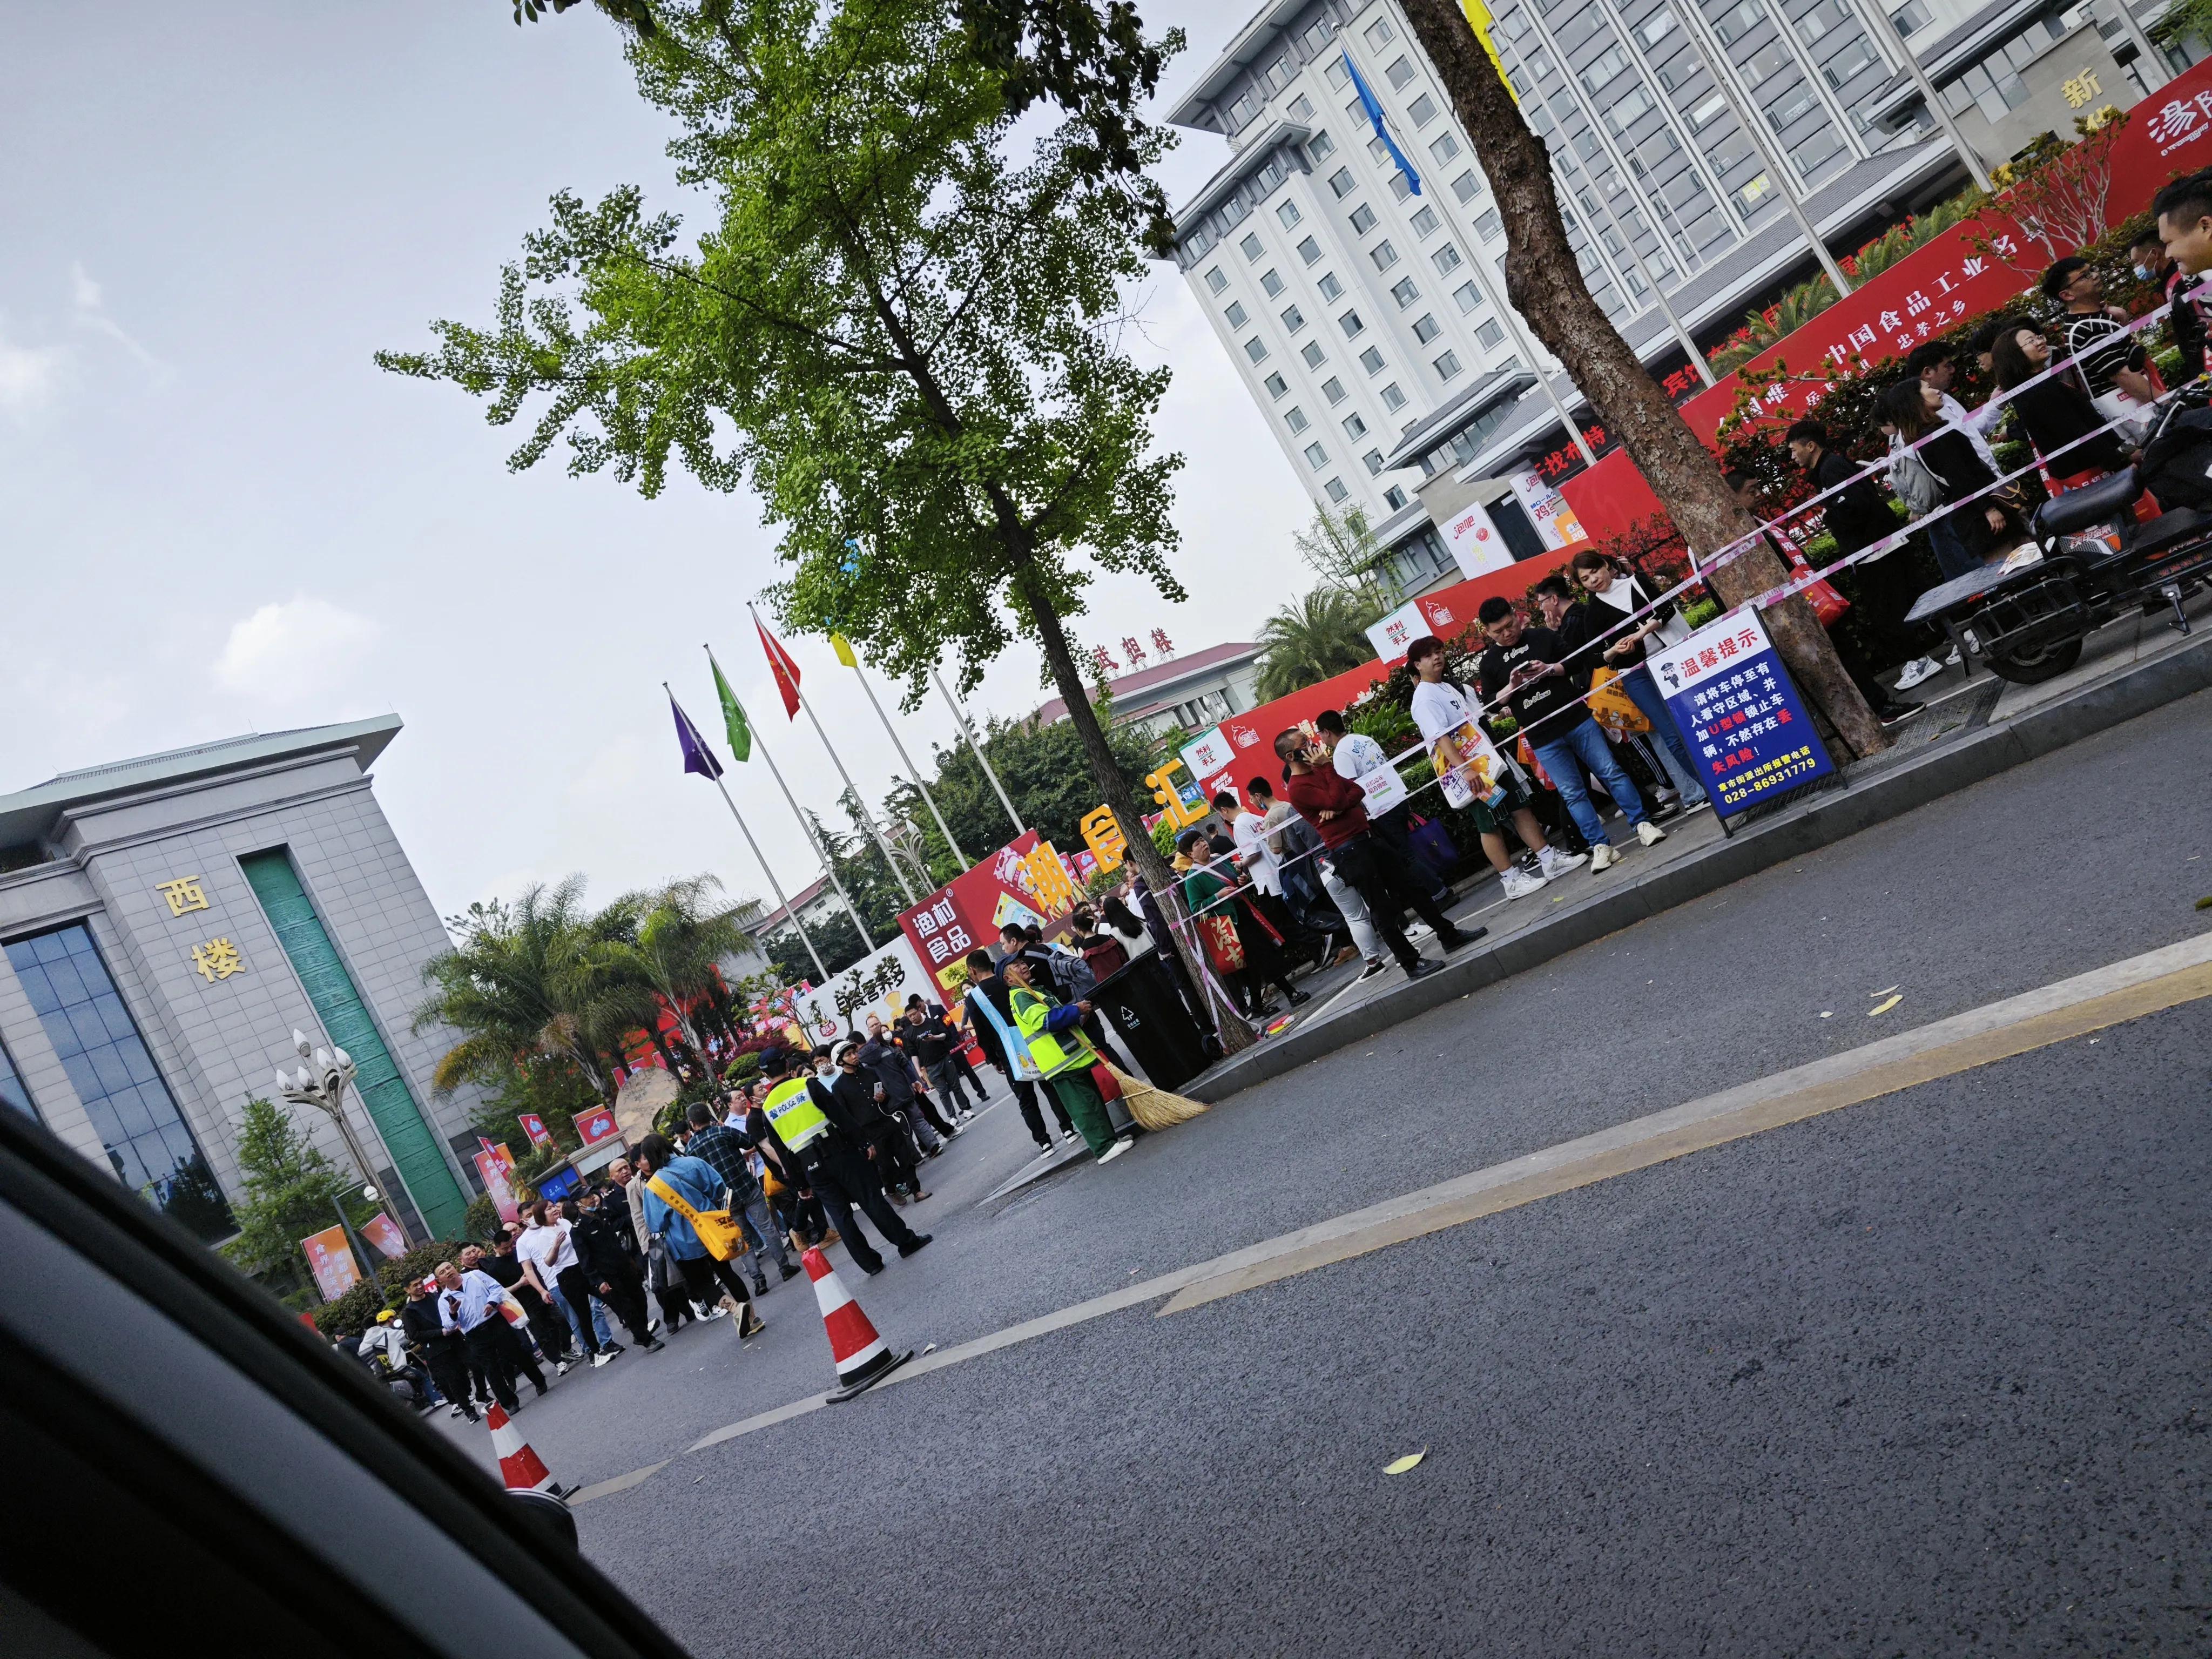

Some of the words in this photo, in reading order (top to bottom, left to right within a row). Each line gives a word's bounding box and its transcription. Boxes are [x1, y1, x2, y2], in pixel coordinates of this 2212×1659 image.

[1896, 299, 1966, 350] 忠孝之乡
[1092, 627, 1175, 670] 武担楼
[1392, 631, 1410, 646] 手工
[1680, 627, 1758, 678] 温馨提示
[1690, 677, 1777, 728] 人看守区域、并
[1693, 661, 1771, 706] 请将车停至有
[1695, 692, 1784, 743] 加U型锁锁止车
[1202, 754, 1216, 766] 手工
[1717, 745, 1811, 793] 草市街派出所报警电话
[1724, 757, 1816, 805] 028-86931779
[154, 874, 247, 983] 西楼
[912, 896, 956, 939] 渔村
[927, 925, 972, 964] 食品
[777, 1098, 797, 1114] POLICE
[334, 1251, 354, 1287] 成都潮
